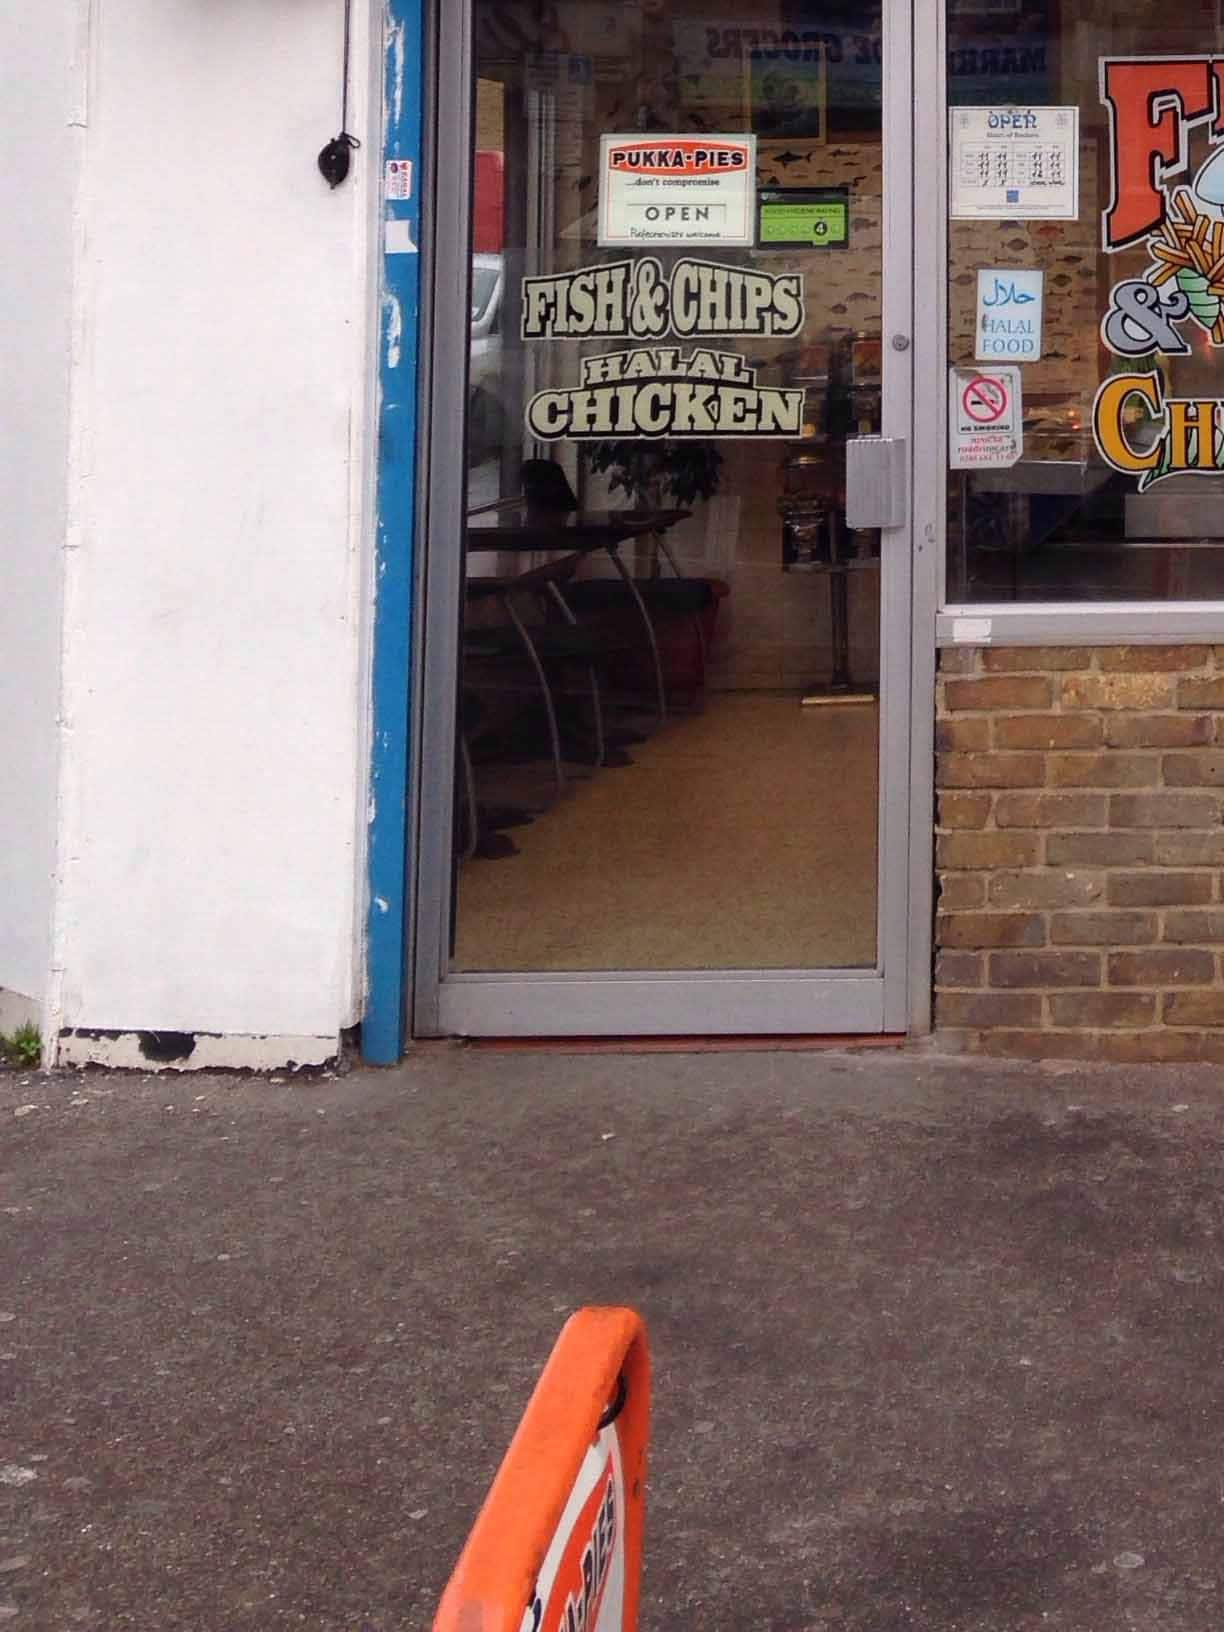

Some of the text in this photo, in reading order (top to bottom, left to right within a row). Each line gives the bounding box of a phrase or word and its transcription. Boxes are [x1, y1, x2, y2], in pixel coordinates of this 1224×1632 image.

[612, 149, 744, 168] PUKKA-PIES
[662, 178, 721, 188] compromise
[644, 206, 710, 222] OPEN
[815, 222, 826, 234] 4
[523, 260, 631, 339] FISH
[671, 257, 805, 338] CHIPS
[982, 278, 1036, 306] حلال
[982, 319, 1035, 335] HALAL
[1103, 280, 1190, 355] &
[983, 338, 1035, 354] FOOD
[583, 347, 755, 386] HALAL
[527, 382, 804, 440] CHICKEN
